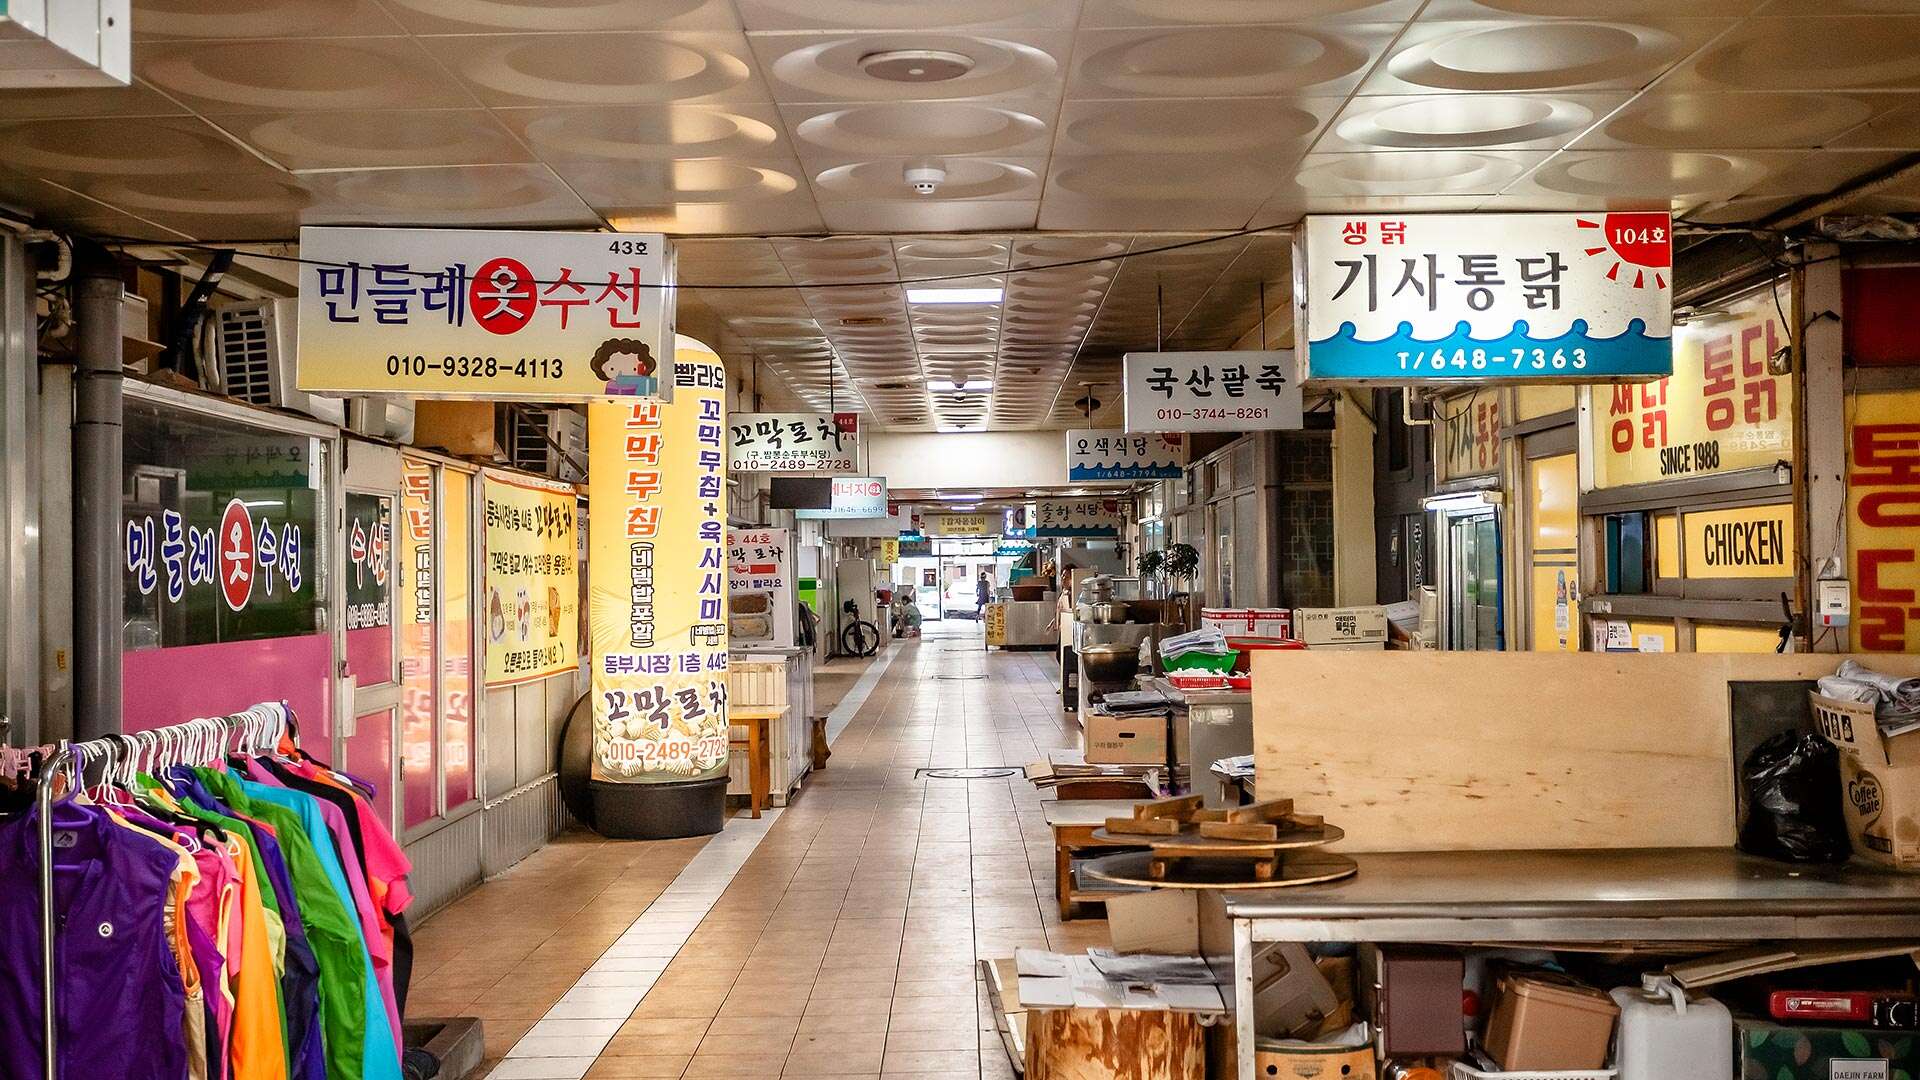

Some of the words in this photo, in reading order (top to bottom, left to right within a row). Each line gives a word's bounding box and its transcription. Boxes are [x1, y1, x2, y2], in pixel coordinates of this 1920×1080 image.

[1342, 220, 1408, 246] 생닭
[1614, 227, 1667, 246] 104호
[609, 240, 649, 256] 43호
[1331, 251, 1569, 312] 기사통닭
[316, 261, 465, 328] 민들레
[538, 266, 642, 330] 수선
[386, 355, 564, 379] 010-9328-4113
[1397, 348, 1588, 370] T/648-7363
[1145, 364, 1287, 400] 국산팥죽
[1703, 319, 1780, 431] 통닭
[1156, 408, 1270, 420] 010-3744-8261
[730, 417, 843, 452] 꼬막포차
[1075, 437, 1148, 457] 오색식당
[626, 402, 662, 537] 꼬막무침
[733, 459, 852, 470] 010-2489-2728
[1660, 444, 1692, 476] SINCE
[1693, 439, 1720, 470] 1988
[697, 399, 723, 621] 꼬막무침+육사시미
[1075, 503, 1099, 517] 식당
[742, 533, 771, 545] 44호
[1705, 518, 1784, 567] CHICKEN
[127, 508, 216, 603] 민들레
[257, 517, 302, 597] 수선
[351, 517, 386, 590] 수선
[754, 545, 784, 563] 포차
[605, 653, 672, 675] 동부시장
[678, 653, 701, 673] 1층
[604, 681, 728, 730] 꼬막포차
[610, 738, 727, 762] 010-2489-2728
[1849, 780, 1879, 808] Coffee
[1858, 799, 1880, 817] mate
[1833, 1071, 1861, 1080] DAEJIN
[1863, 1071, 1885, 1080] FARM
